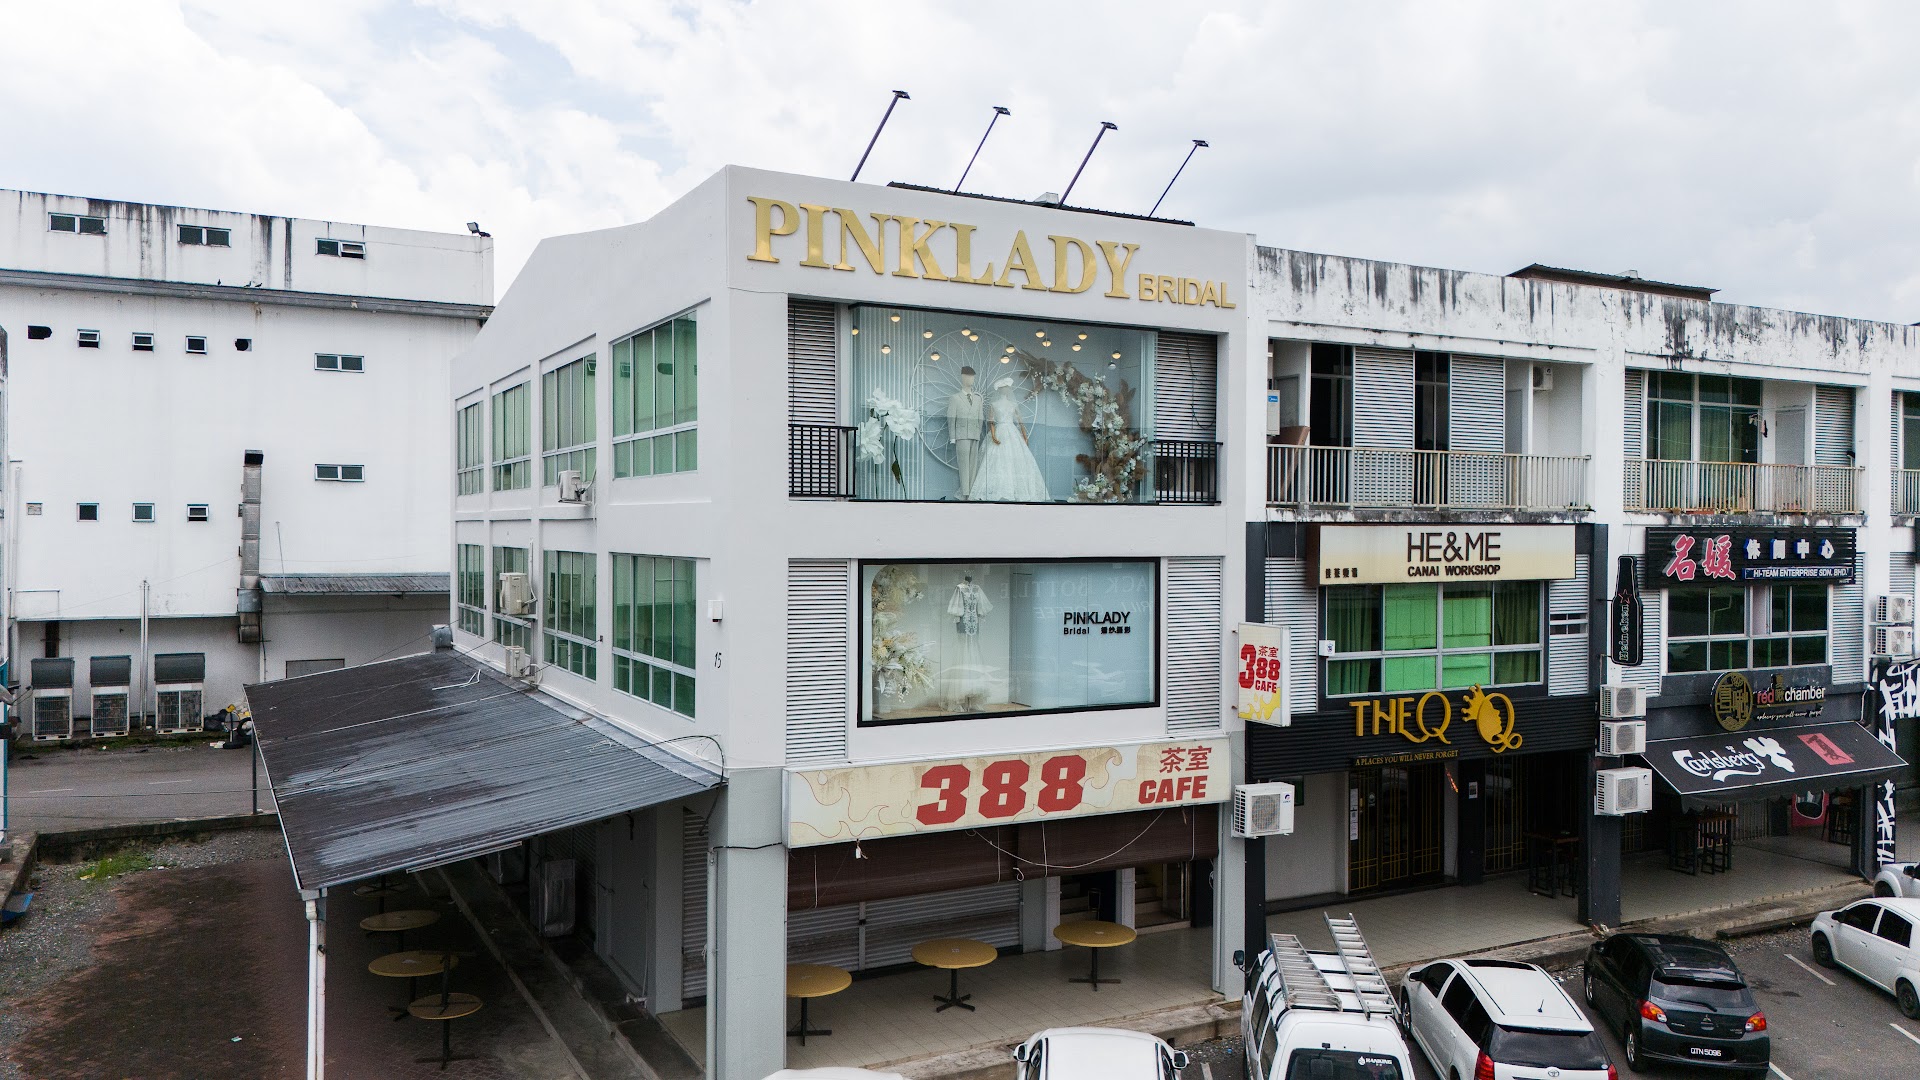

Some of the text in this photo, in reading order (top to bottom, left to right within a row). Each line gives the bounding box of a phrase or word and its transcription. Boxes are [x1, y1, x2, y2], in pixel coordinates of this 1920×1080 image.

[747, 196, 1236, 310] PINKLADY BRIDAL
[1407, 531, 1501, 563] HE&ME
[1666, 534, 1736, 581] 名媛
[1408, 565, 1501, 577] CANAI WORKSHOP
[1753, 569, 1778, 578] HI-TEAM
[1779, 568, 1818, 578] ENTERPRISE
[1063, 611, 1131, 625] PINKLADY
[1063, 627, 1090, 635] Bridal
[1618, 604, 1629, 661] Heineken
[1258, 645, 1279, 658] 茶室
[1238, 643, 1281, 689] 388
[1255, 680, 1278, 694] CAFE
[1757, 688, 1775, 704] red
[1784, 685, 1826, 701] chamber
[1159, 746, 1212, 774] 茶室
[1361, 756, 1384, 766] PLACES
[1384, 756, 1398, 764] YOU
[1398, 754, 1413, 762] WILL
[1414, 752, 1434, 761] NEVER
[1435, 750, 1459, 759] FORGET
[1672, 748, 1766, 782] Carlsberg
[916, 755, 1087, 826] 388
[1138, 775, 1208, 805] CAFE
